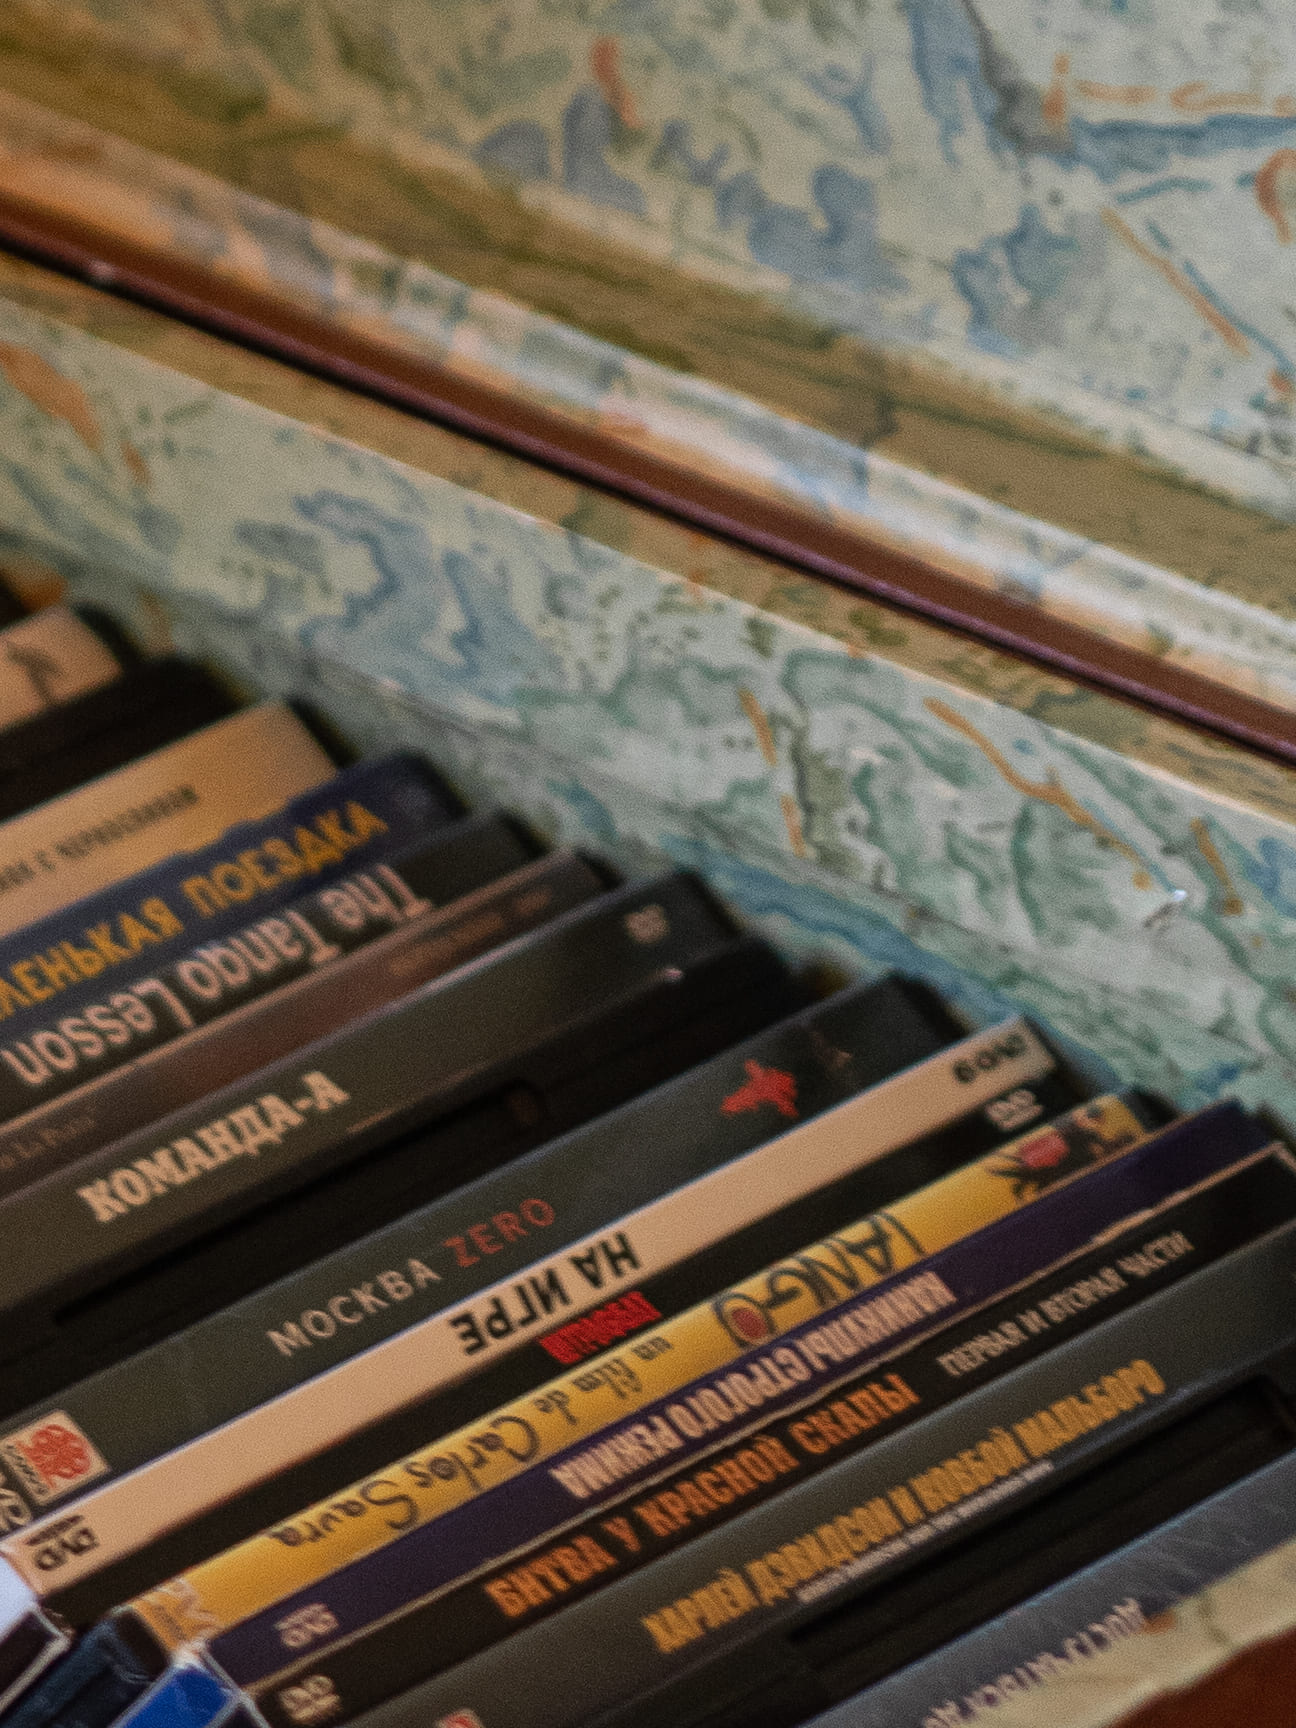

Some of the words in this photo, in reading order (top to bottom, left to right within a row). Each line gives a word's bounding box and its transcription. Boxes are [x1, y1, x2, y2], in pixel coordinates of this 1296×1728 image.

[181, 801, 389, 917] ПОЕЗДКА
[319, 864, 432, 929] The
[181, 910, 339, 1000] Tango
[0, 977, 196, 1085] Lesson
[77, 1071, 348, 1223] КОМАНДА-А
[266, 1259, 443, 1357] МОСКВА
[445, 1198, 555, 1268] ZERO
[570, 1231, 641, 1289] НА
[713, 1213, 928, 1345] TANGO
[448, 1272, 571, 1356] ИГРЕ
[798, 1271, 957, 1371] КАНИКУЛЫ
[937, 1332, 1021, 1376] ПЕРВАЯ
[1039, 1267, 1128, 1326] ВТОРАЯ
[533, 1389, 579, 1427] de
[571, 1357, 644, 1399] film
[666, 1341, 814, 1438] СТРОГОГО
[414, 1409, 542, 1495] Carlos
[485, 1531, 616, 1617] БИТВА
[604, 1516, 642, 1552] У
[633, 1434, 800, 1537] КРАСНОЙ
[787, 1372, 922, 1456] СКАЛЫ
[548, 1413, 682, 1500] РЕЖИМА
[271, 1477, 421, 1549] Saura
[643, 1566, 759, 1653] ХАРЛЕЙ
[888, 1485, 925, 1524] И
[1013, 1358, 1167, 1460] МАЛЬБОРО
